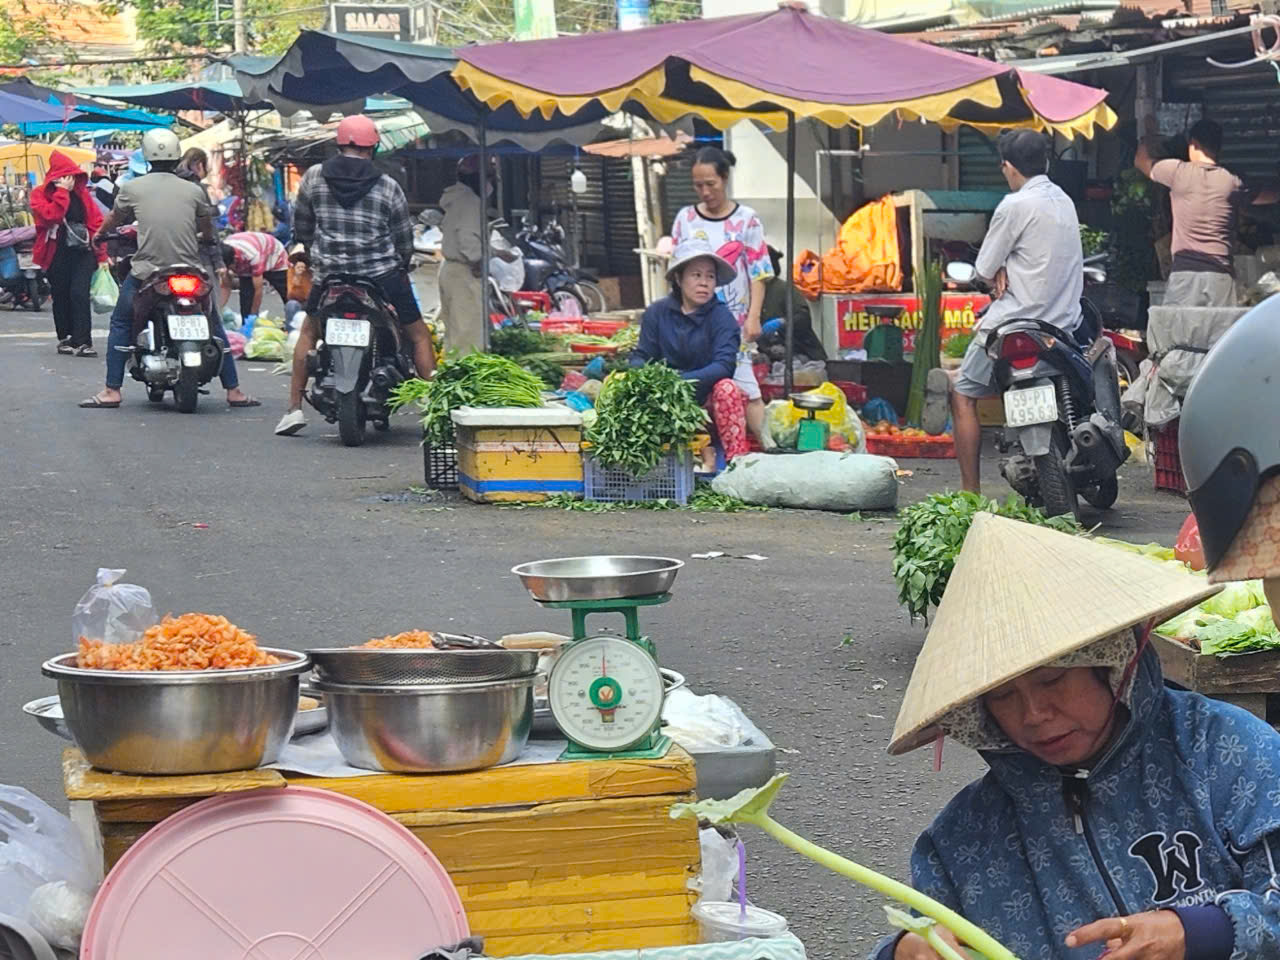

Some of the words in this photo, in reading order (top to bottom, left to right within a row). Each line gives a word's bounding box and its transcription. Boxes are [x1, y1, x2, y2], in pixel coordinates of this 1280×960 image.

[345, 12, 400, 32] SALON
[1013, 389, 1047, 408] 59-P1
[1128, 831, 1203, 904] W
